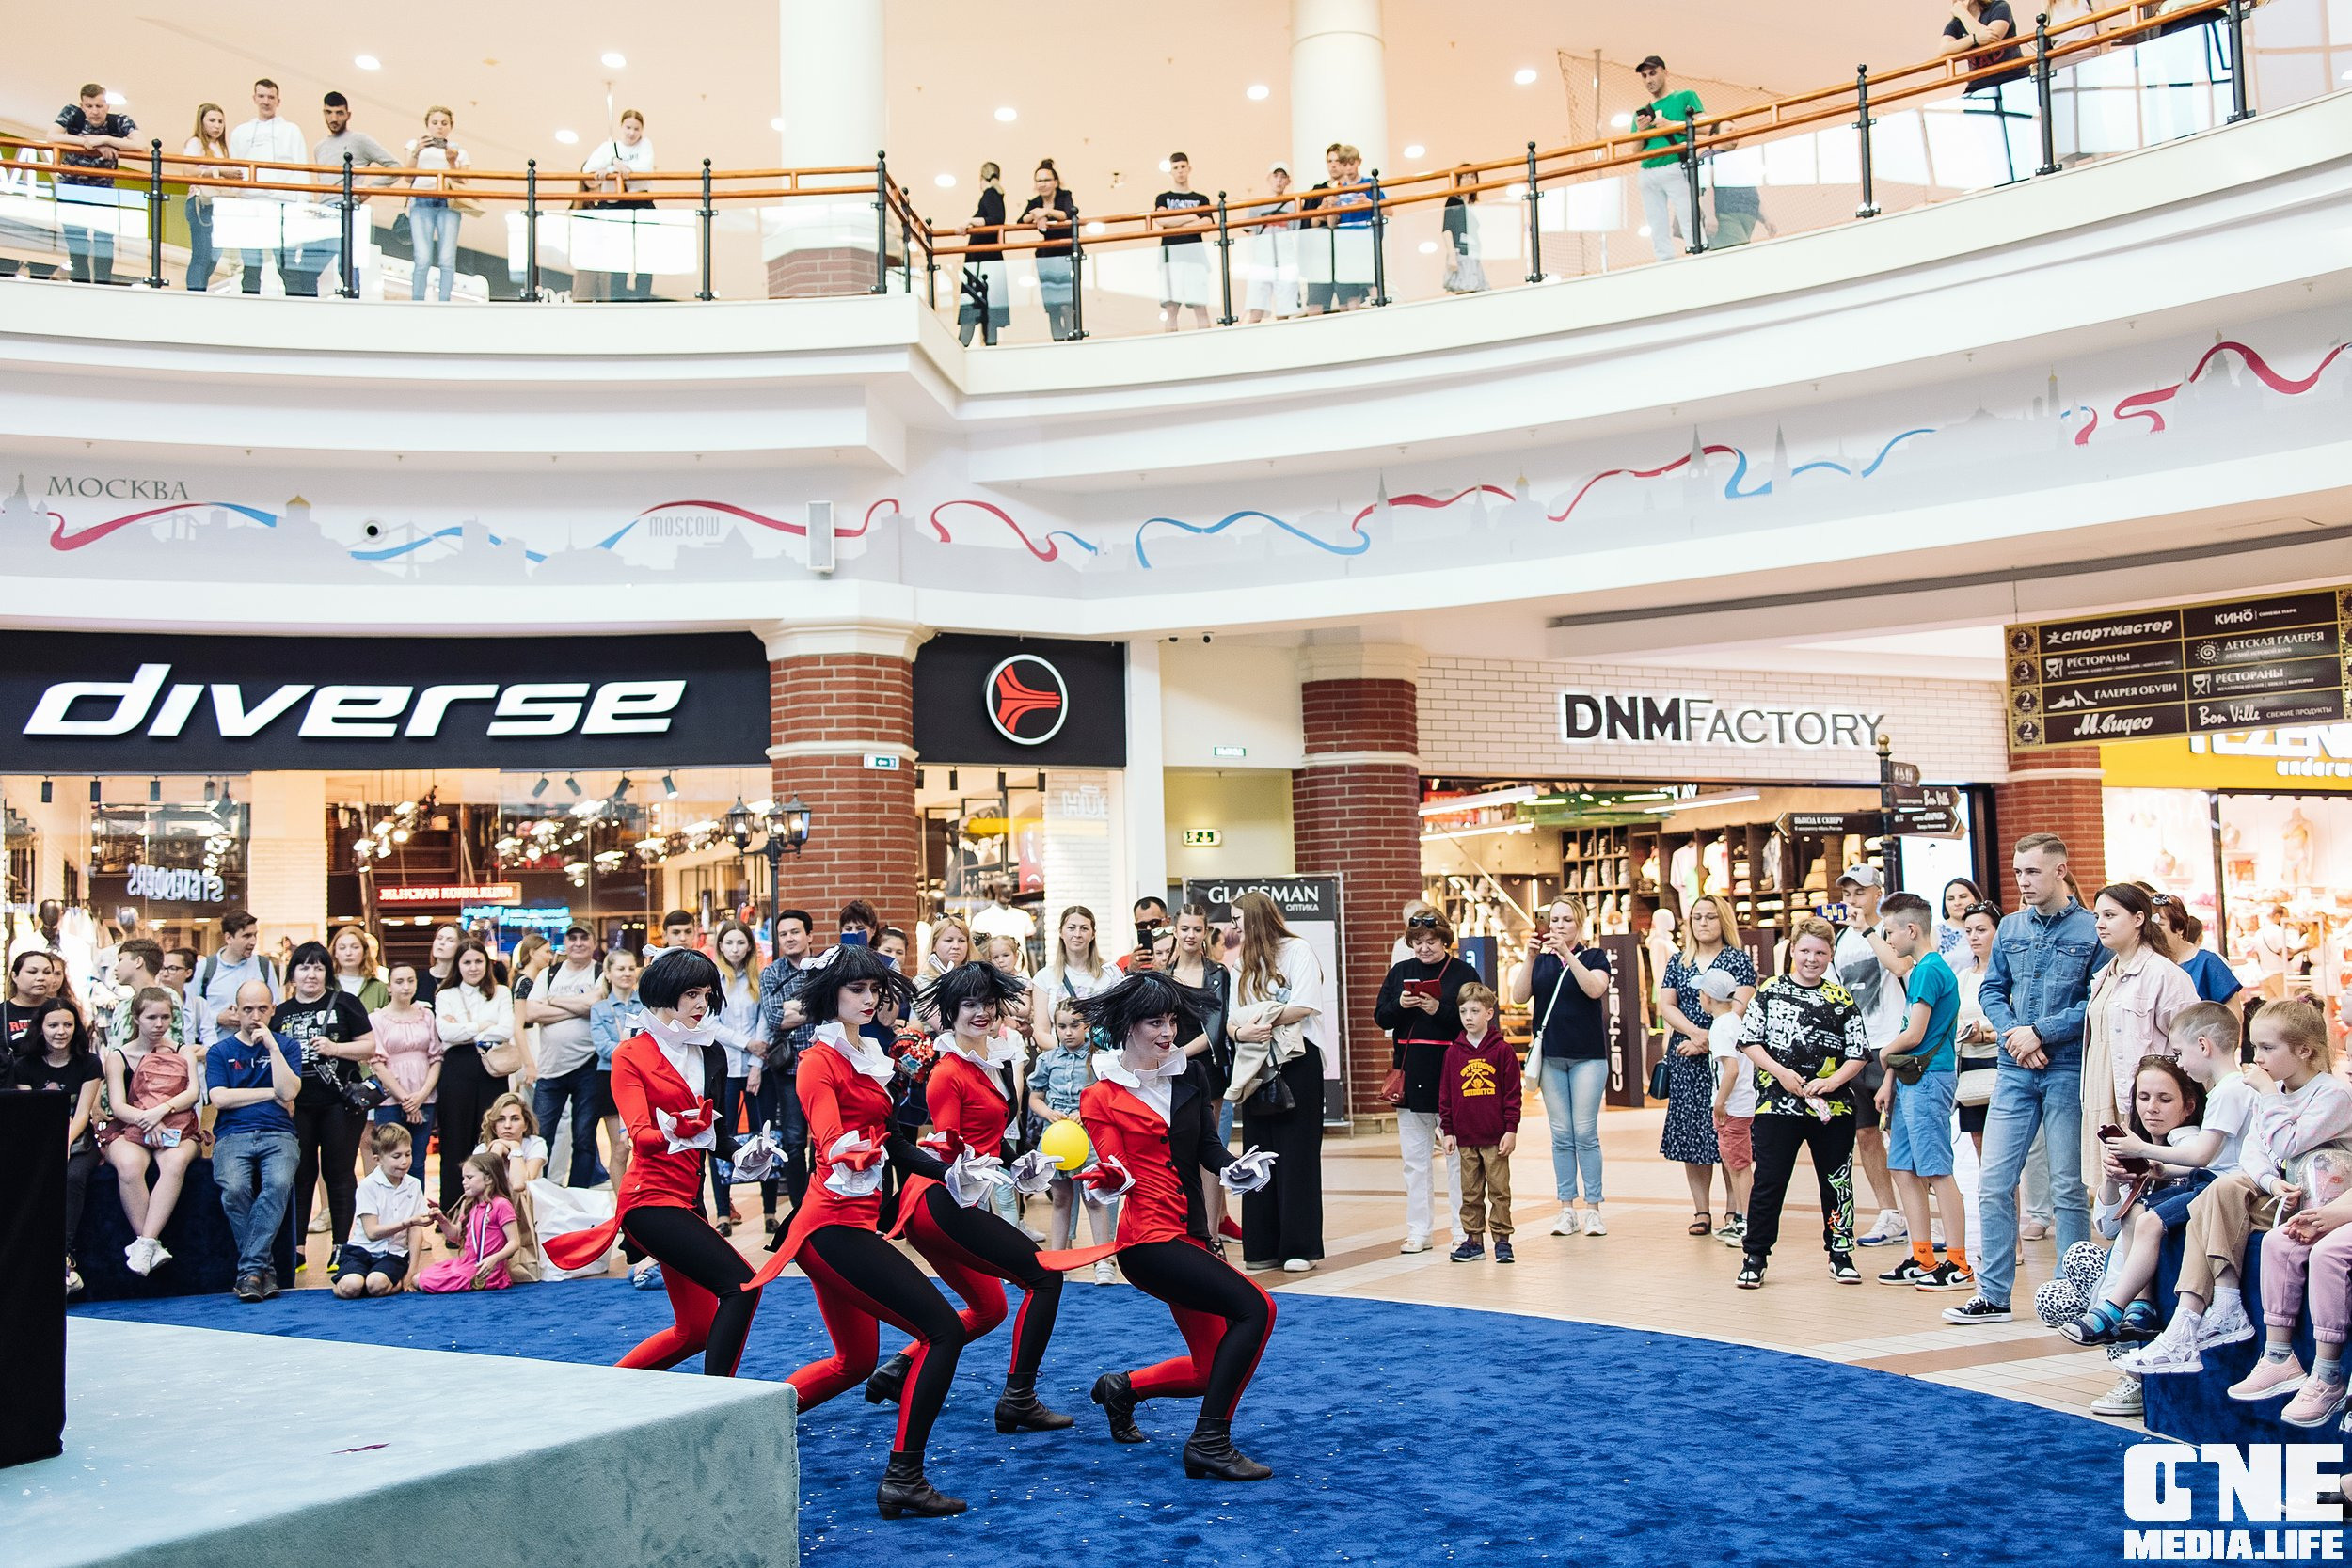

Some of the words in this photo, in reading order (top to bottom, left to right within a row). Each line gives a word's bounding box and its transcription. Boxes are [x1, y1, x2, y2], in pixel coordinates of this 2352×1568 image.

[47, 475, 190, 500] МОСКВА
[649, 515, 720, 537] MOSCOW
[2018, 631, 2027, 647] 3
[2061, 620, 2173, 642] спортмастер
[2224, 637, 2275, 652] ДЕТСКАЯ
[2277, 631, 2325, 646] ГАЛЕРЕЯ
[2067, 653, 2130, 668] РЕСТОРАНЫ
[2019, 661, 2029, 677] 3
[2216, 669, 2284, 684] РЕСТОРАНЫ
[2021, 691, 2031, 707] 2
[2094, 685, 2138, 700] ГАЛЕРЕЯ
[2138, 683, 2178, 697] ОБУВИ
[22, 663, 687, 738] diverse
[2198, 705, 2228, 727] Bon
[2230, 704, 2261, 723] Ville
[2266, 709, 2294, 719] СВЕЖИЕ
[2295, 706, 2333, 718] ПРОДУКТЫ
[2023, 721, 2033, 736] 2
